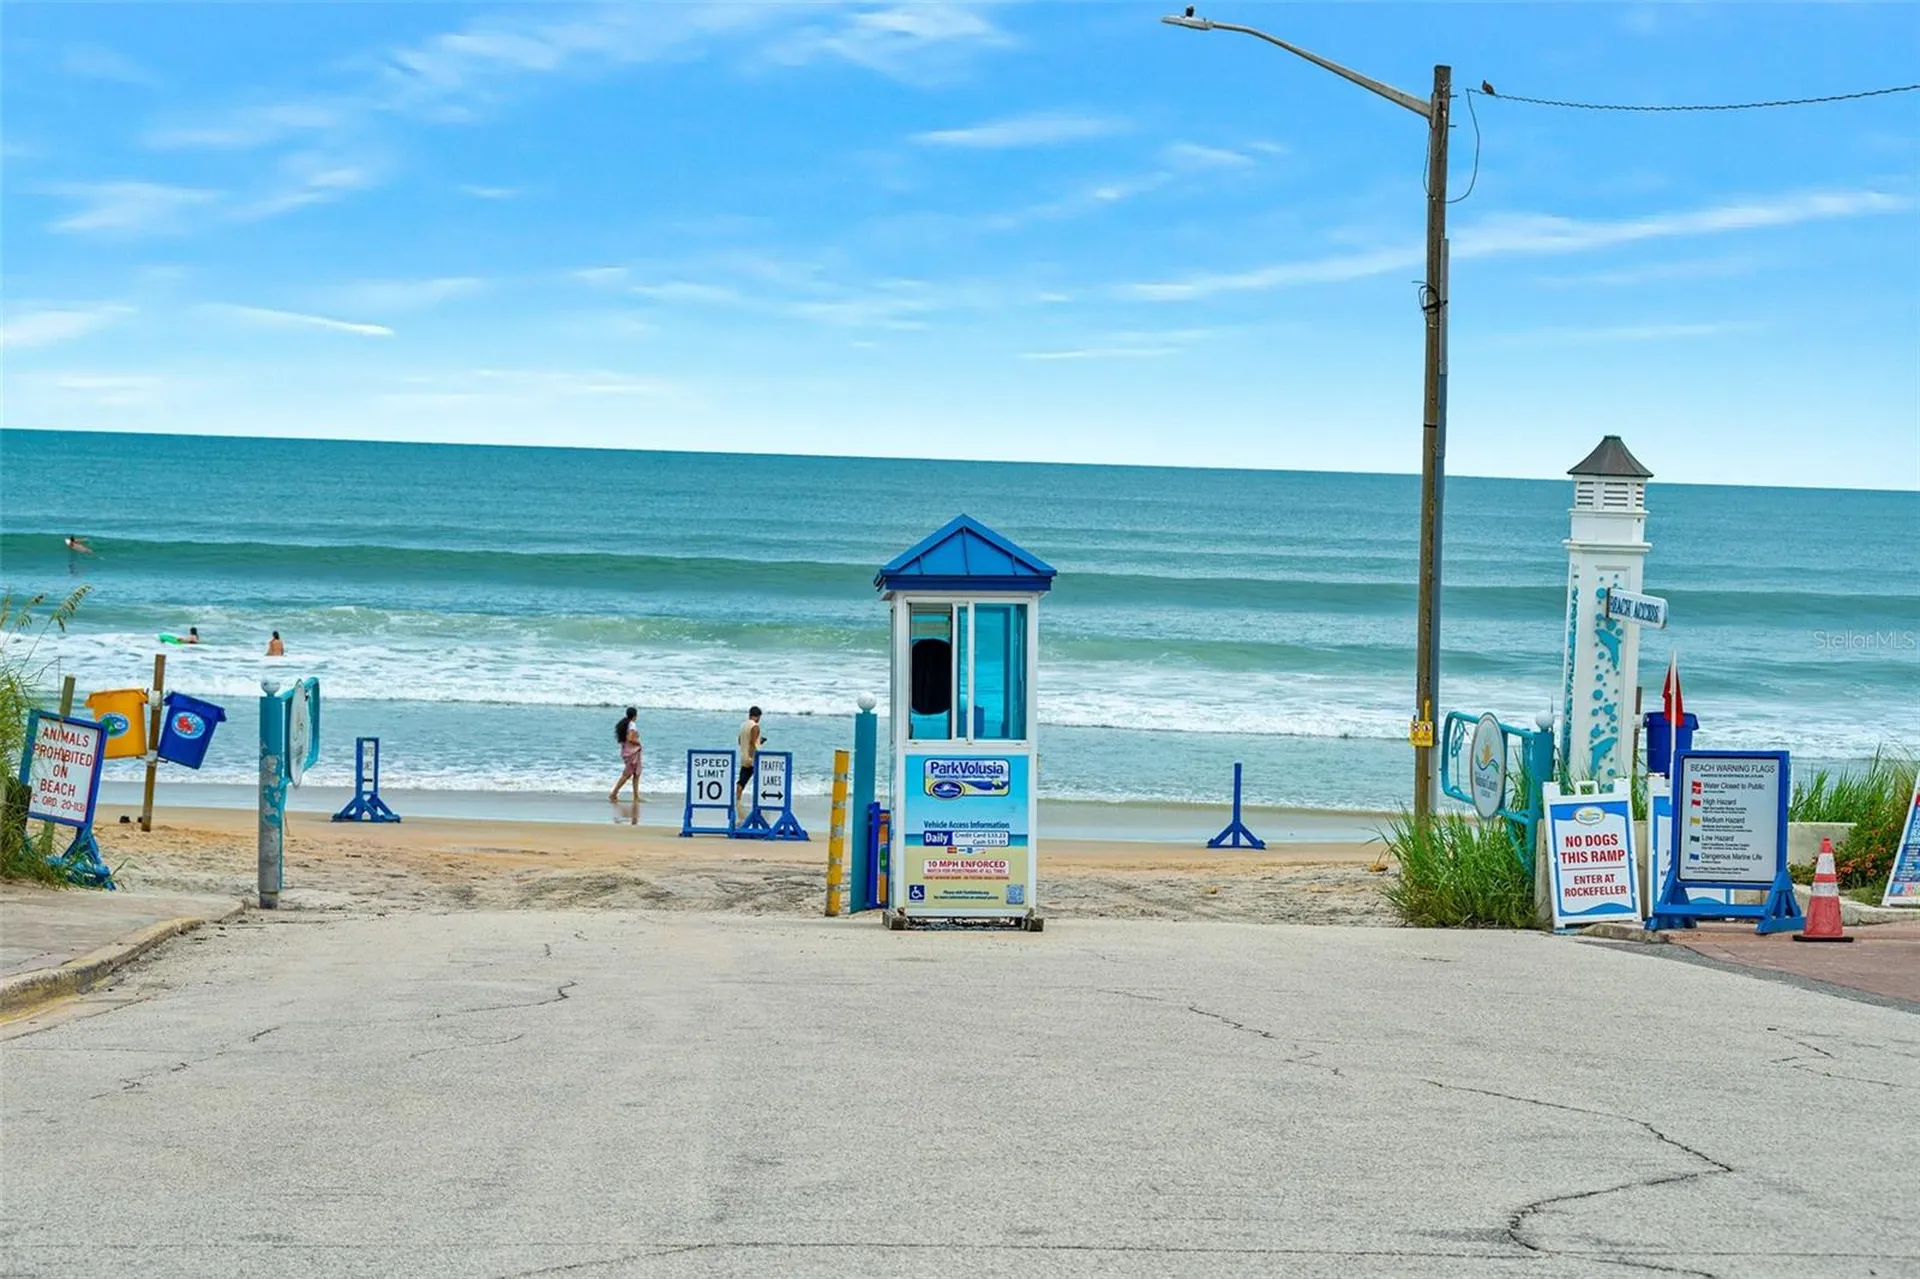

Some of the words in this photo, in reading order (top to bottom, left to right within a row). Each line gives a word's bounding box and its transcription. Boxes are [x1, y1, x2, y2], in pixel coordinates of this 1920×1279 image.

[41, 727, 90, 748] ANIMALS
[32, 742, 93, 767] PROHIBITED
[694, 758, 730, 768] SPEED
[760, 760, 785, 773] TRAFFIC
[930, 761, 1004, 775] ParkVolusia
[1690, 763, 1715, 772] BEACH
[1716, 764, 1750, 773] WARNING
[1751, 764, 1775, 773] FLAGS
[52, 764, 69, 779] ON
[697, 769, 726, 779] LIMIT
[40, 778, 76, 797] BEACH
[762, 775, 782, 787] LANES
[696, 780, 723, 800] 10
[1702, 799, 1716, 807] High
[923, 821, 948, 829] Vehicle
[948, 821, 970, 829] Access
[970, 821, 1010, 829] Information
[925, 832, 949, 845] Daily
[1565, 835, 1583, 848] NO
[1585, 834, 1618, 846] DOGS
[1560, 851, 1589, 864] THIS
[1590, 849, 1626, 863] RAMP
[1701, 853, 1731, 862] Dangerous
[928, 860, 938, 868] 10
[939, 860, 959, 868] MPH
[960, 860, 1006, 868] ENFORCED
[1573, 875, 1603, 885] ENTER
[1604, 874, 1616, 883] AT
[1564, 885, 1627, 898] ROCKEFELLER
